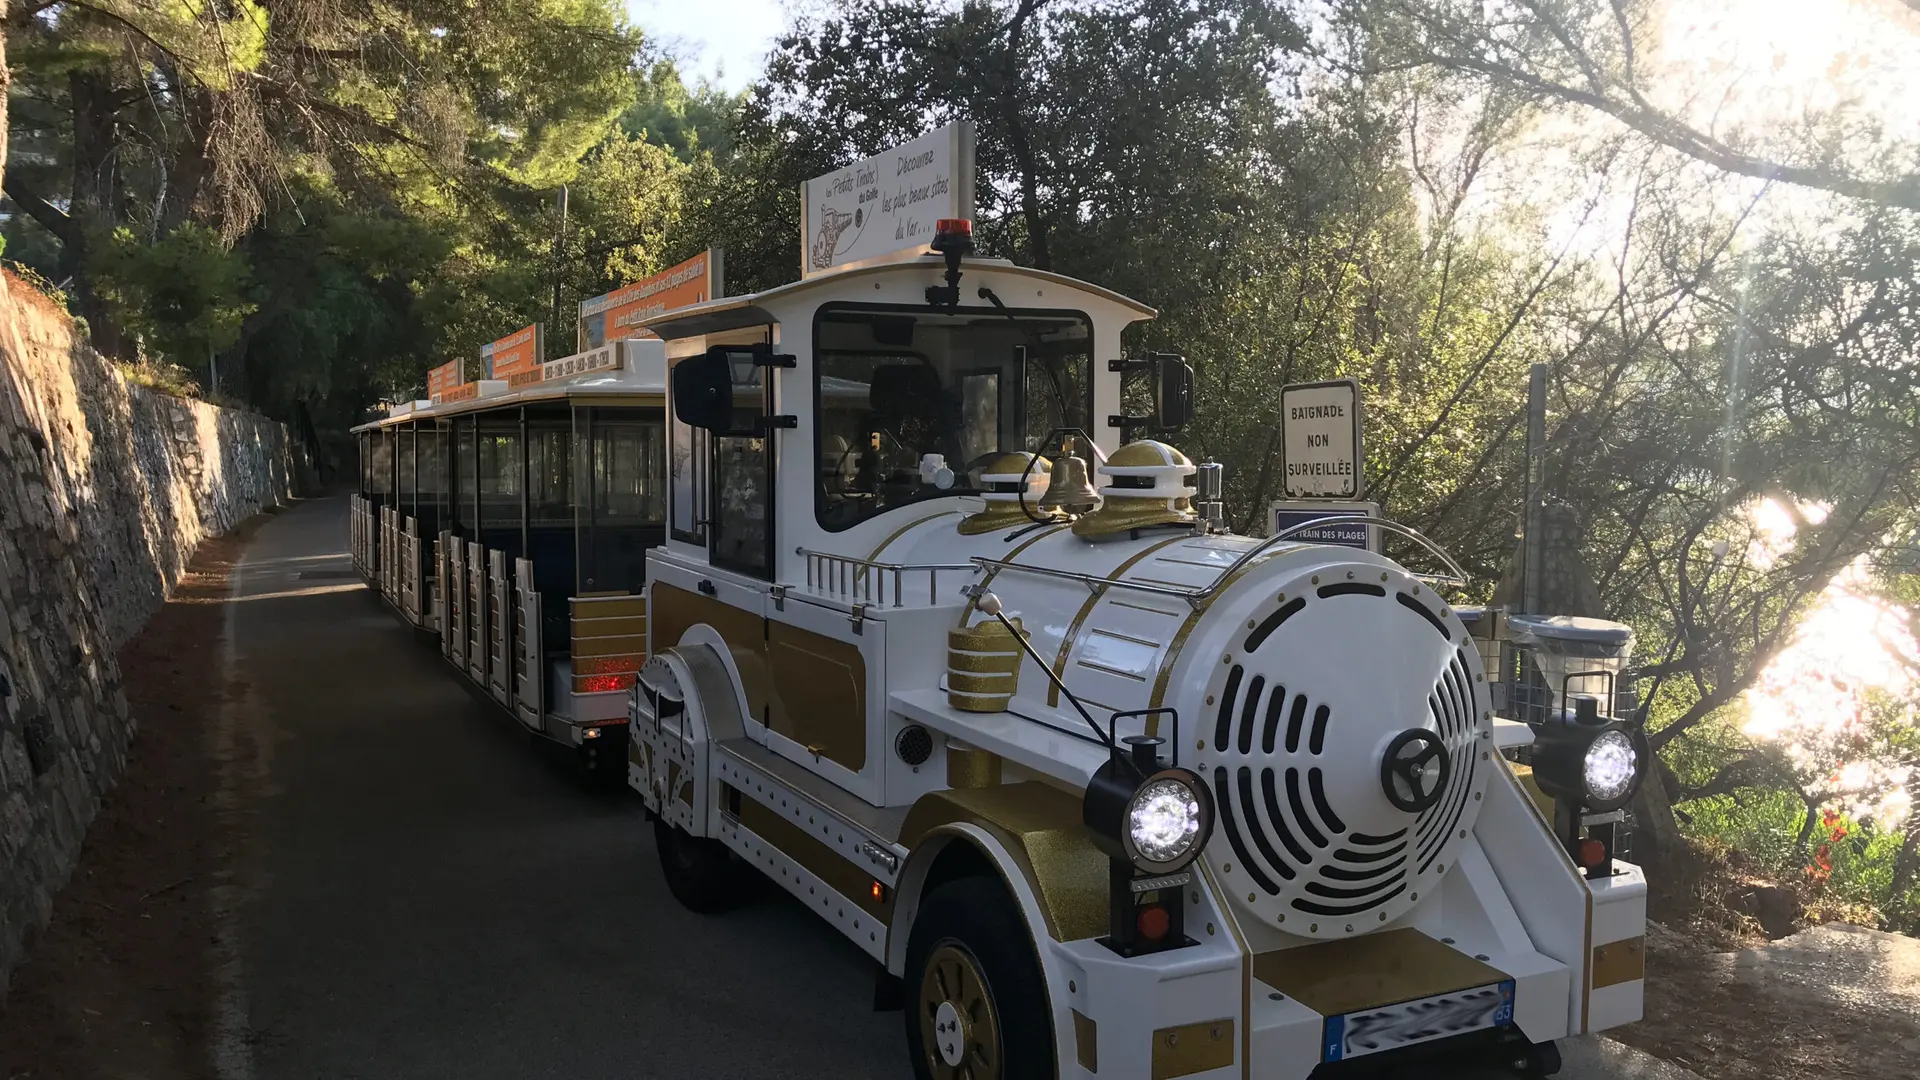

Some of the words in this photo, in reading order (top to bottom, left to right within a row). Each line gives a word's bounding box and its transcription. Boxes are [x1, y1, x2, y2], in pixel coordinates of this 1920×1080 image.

[897, 150, 934, 176] Découvrez
[892, 185, 907, 218] plus
[909, 181, 929, 206] beaux
[930, 174, 949, 198] sites
[895, 218, 904, 241] du
[1291, 405, 1344, 420] BAIGNADE
[1307, 434, 1329, 448] NON
[1288, 459, 1352, 476] SURVEILLÉE
[1299, 530, 1320, 539] TRAIN
[1322, 530, 1336, 539] DES
[1337, 530, 1366, 540] PLAGES
[1330, 1044, 1338, 1056] F
